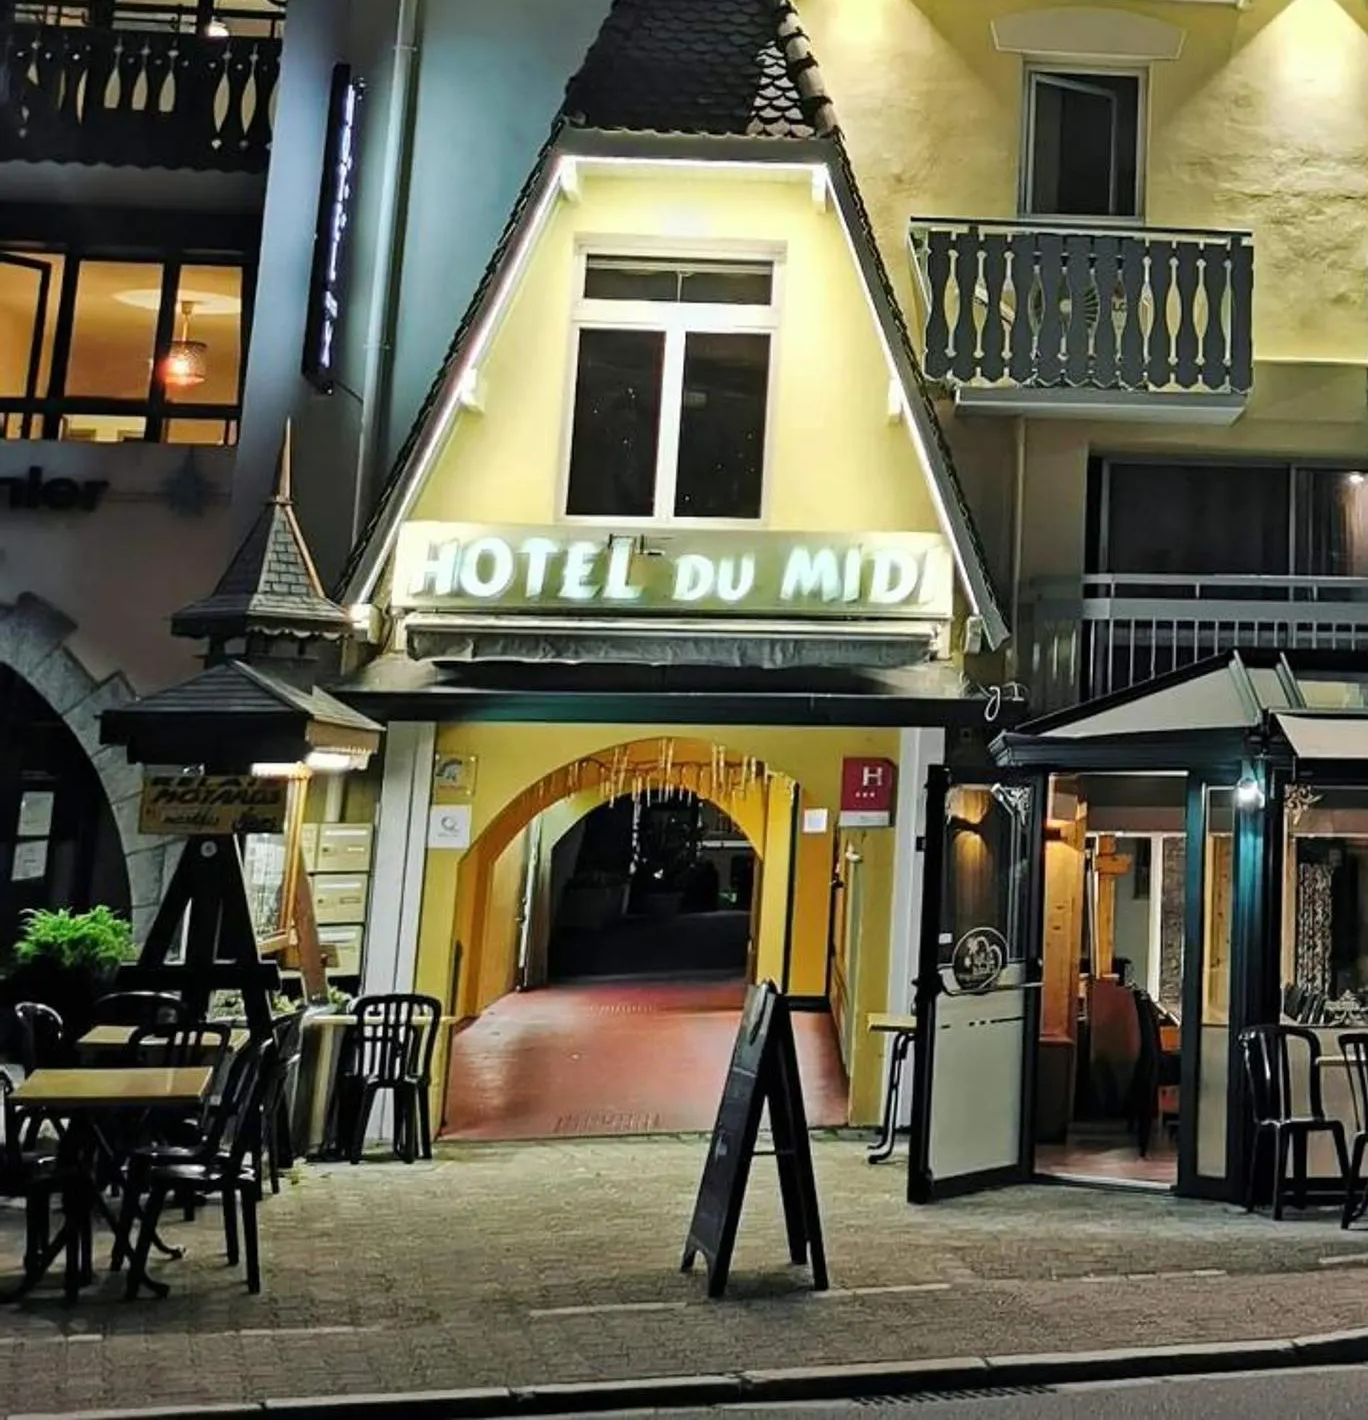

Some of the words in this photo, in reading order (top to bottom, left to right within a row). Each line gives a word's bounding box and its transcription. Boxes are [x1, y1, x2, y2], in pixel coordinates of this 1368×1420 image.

[409, 536, 643, 600] HOTEL
[672, 553, 755, 601] DU
[779, 544, 947, 603] MIDI
[863, 766, 882, 787] H
